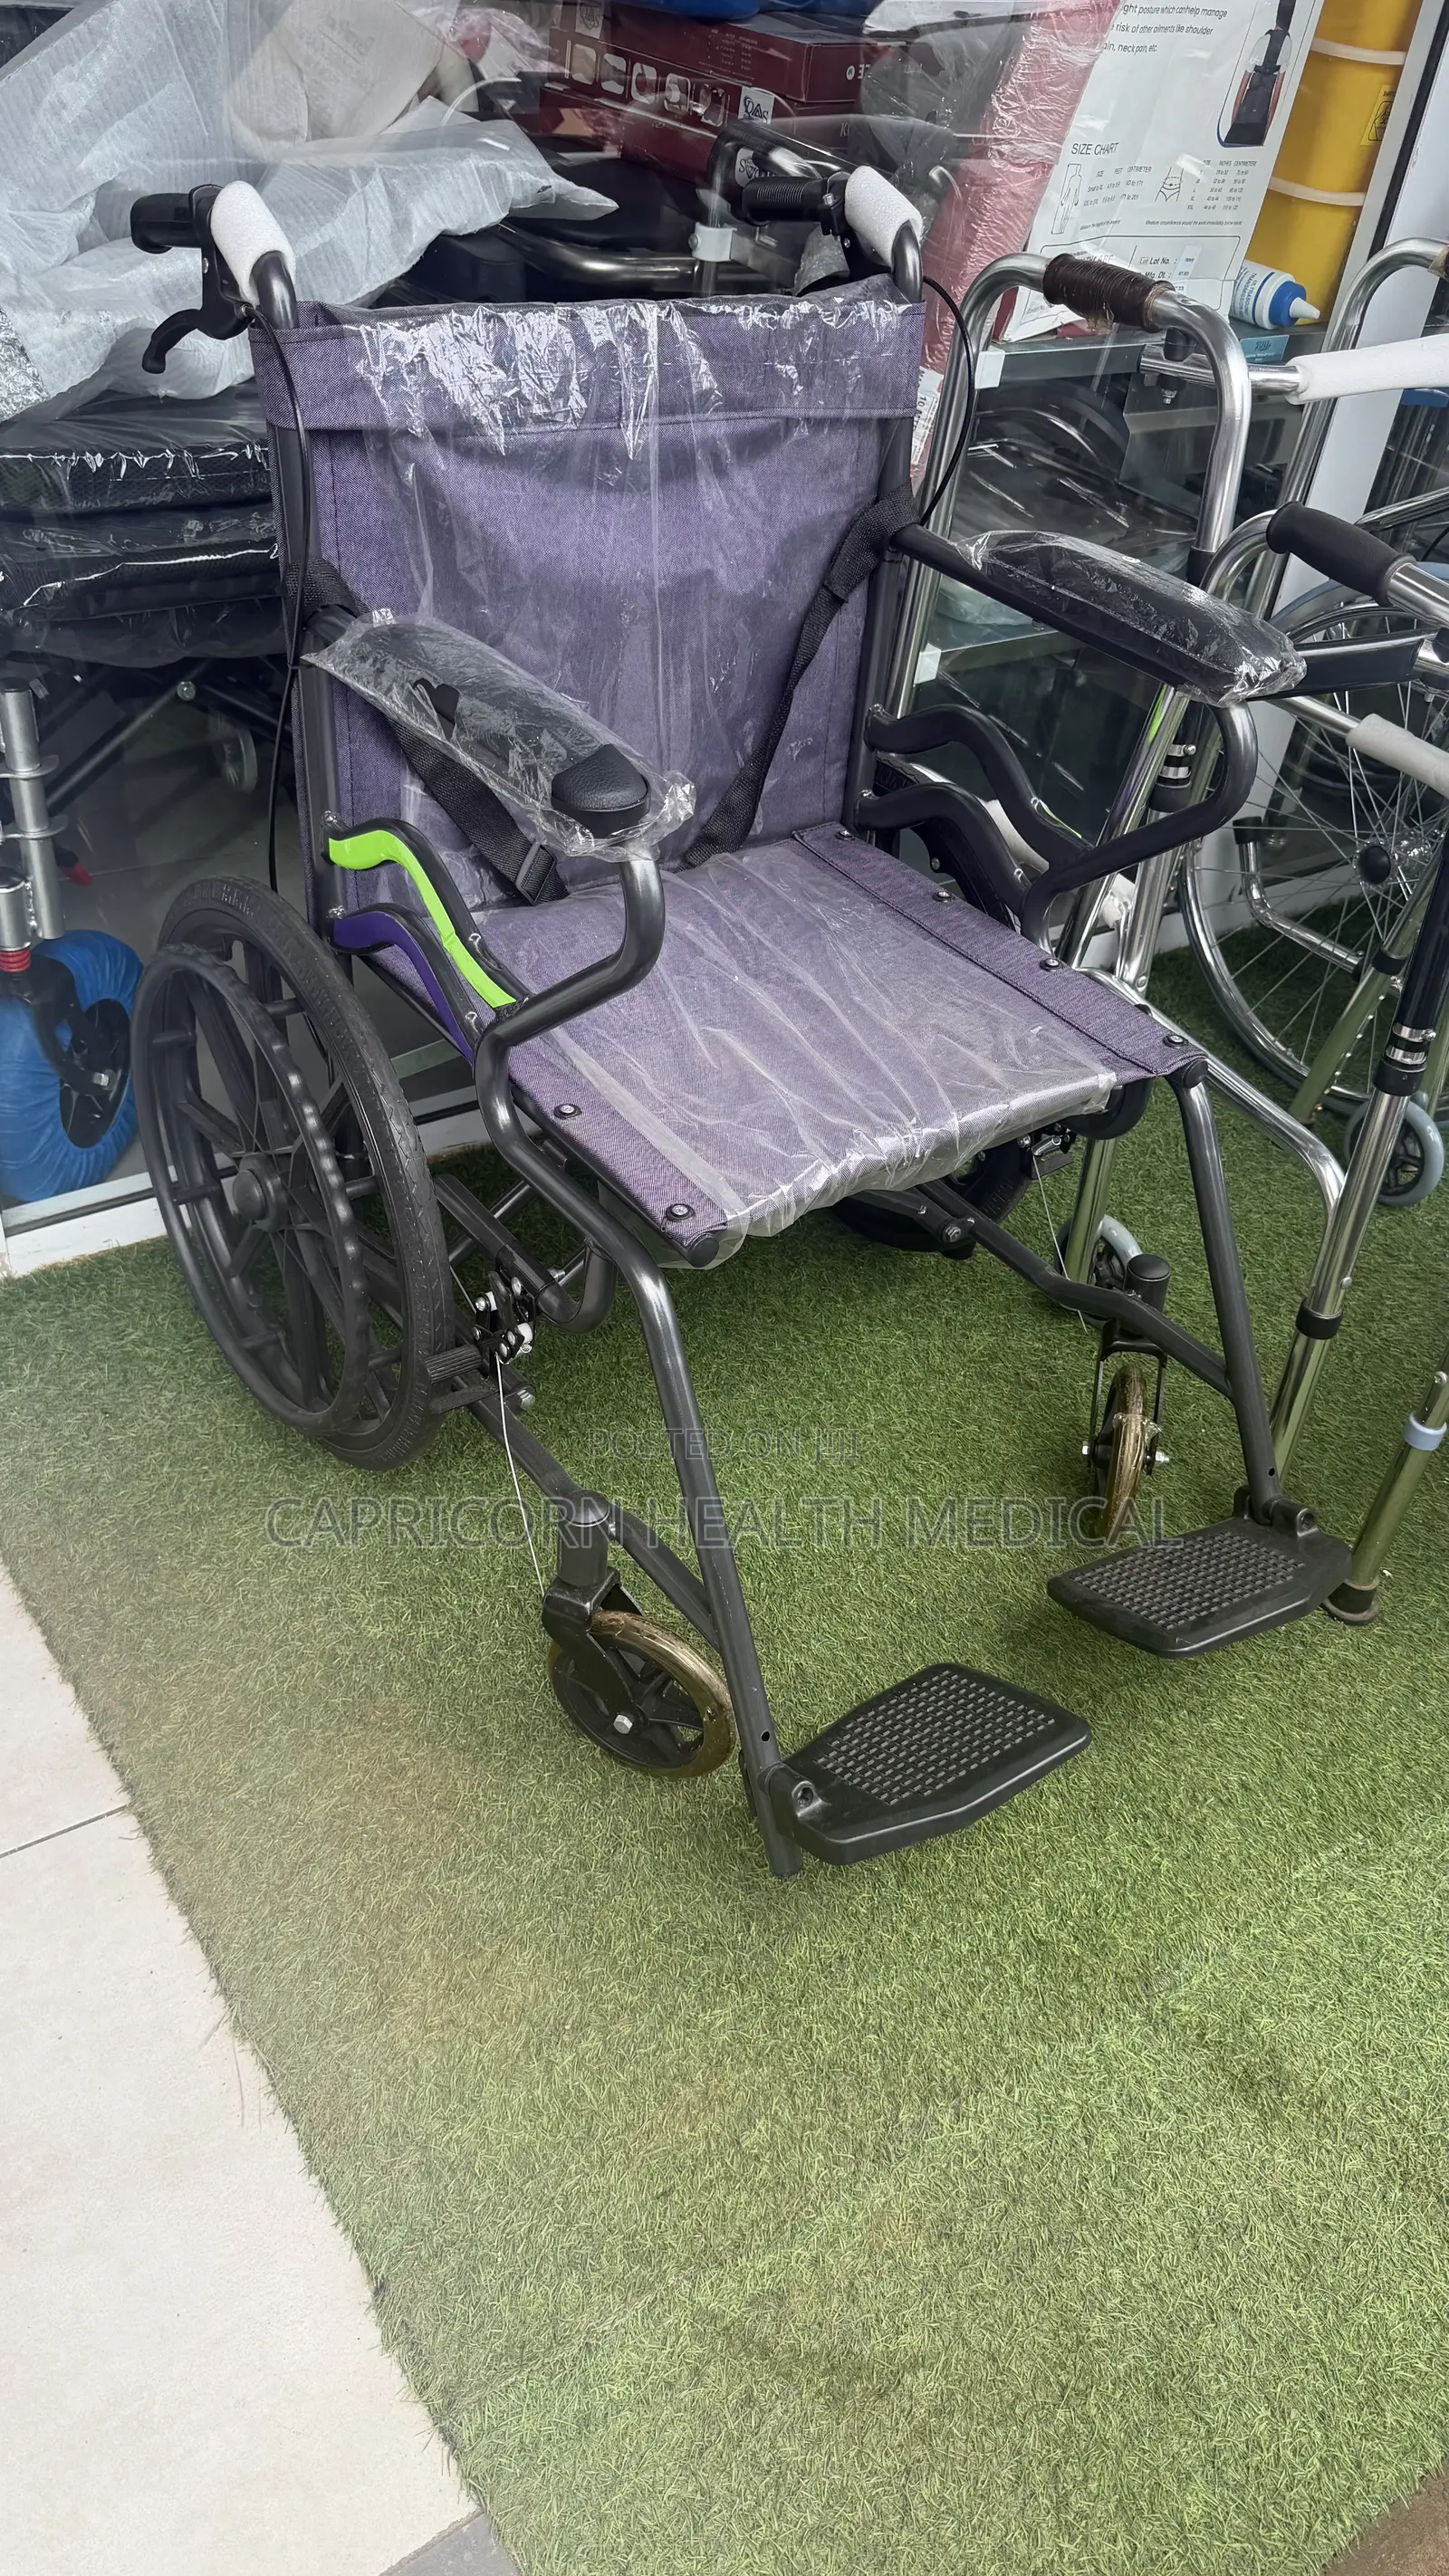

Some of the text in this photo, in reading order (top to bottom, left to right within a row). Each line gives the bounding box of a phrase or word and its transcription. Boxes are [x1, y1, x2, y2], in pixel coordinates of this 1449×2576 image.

[1120, 4, 1137, 14] ght
[1137, 5, 1159, 16] posture
[1160, 5, 1176, 14] which
[1201, 8, 1228, 19] manage
[1116, 22, 1214, 34] risk of other ailments like shoulder
[1118, 44, 1136, 53] neck
[1071, 142, 1119, 156] SIZE CHART
[917, 396, 927, 407] 10
